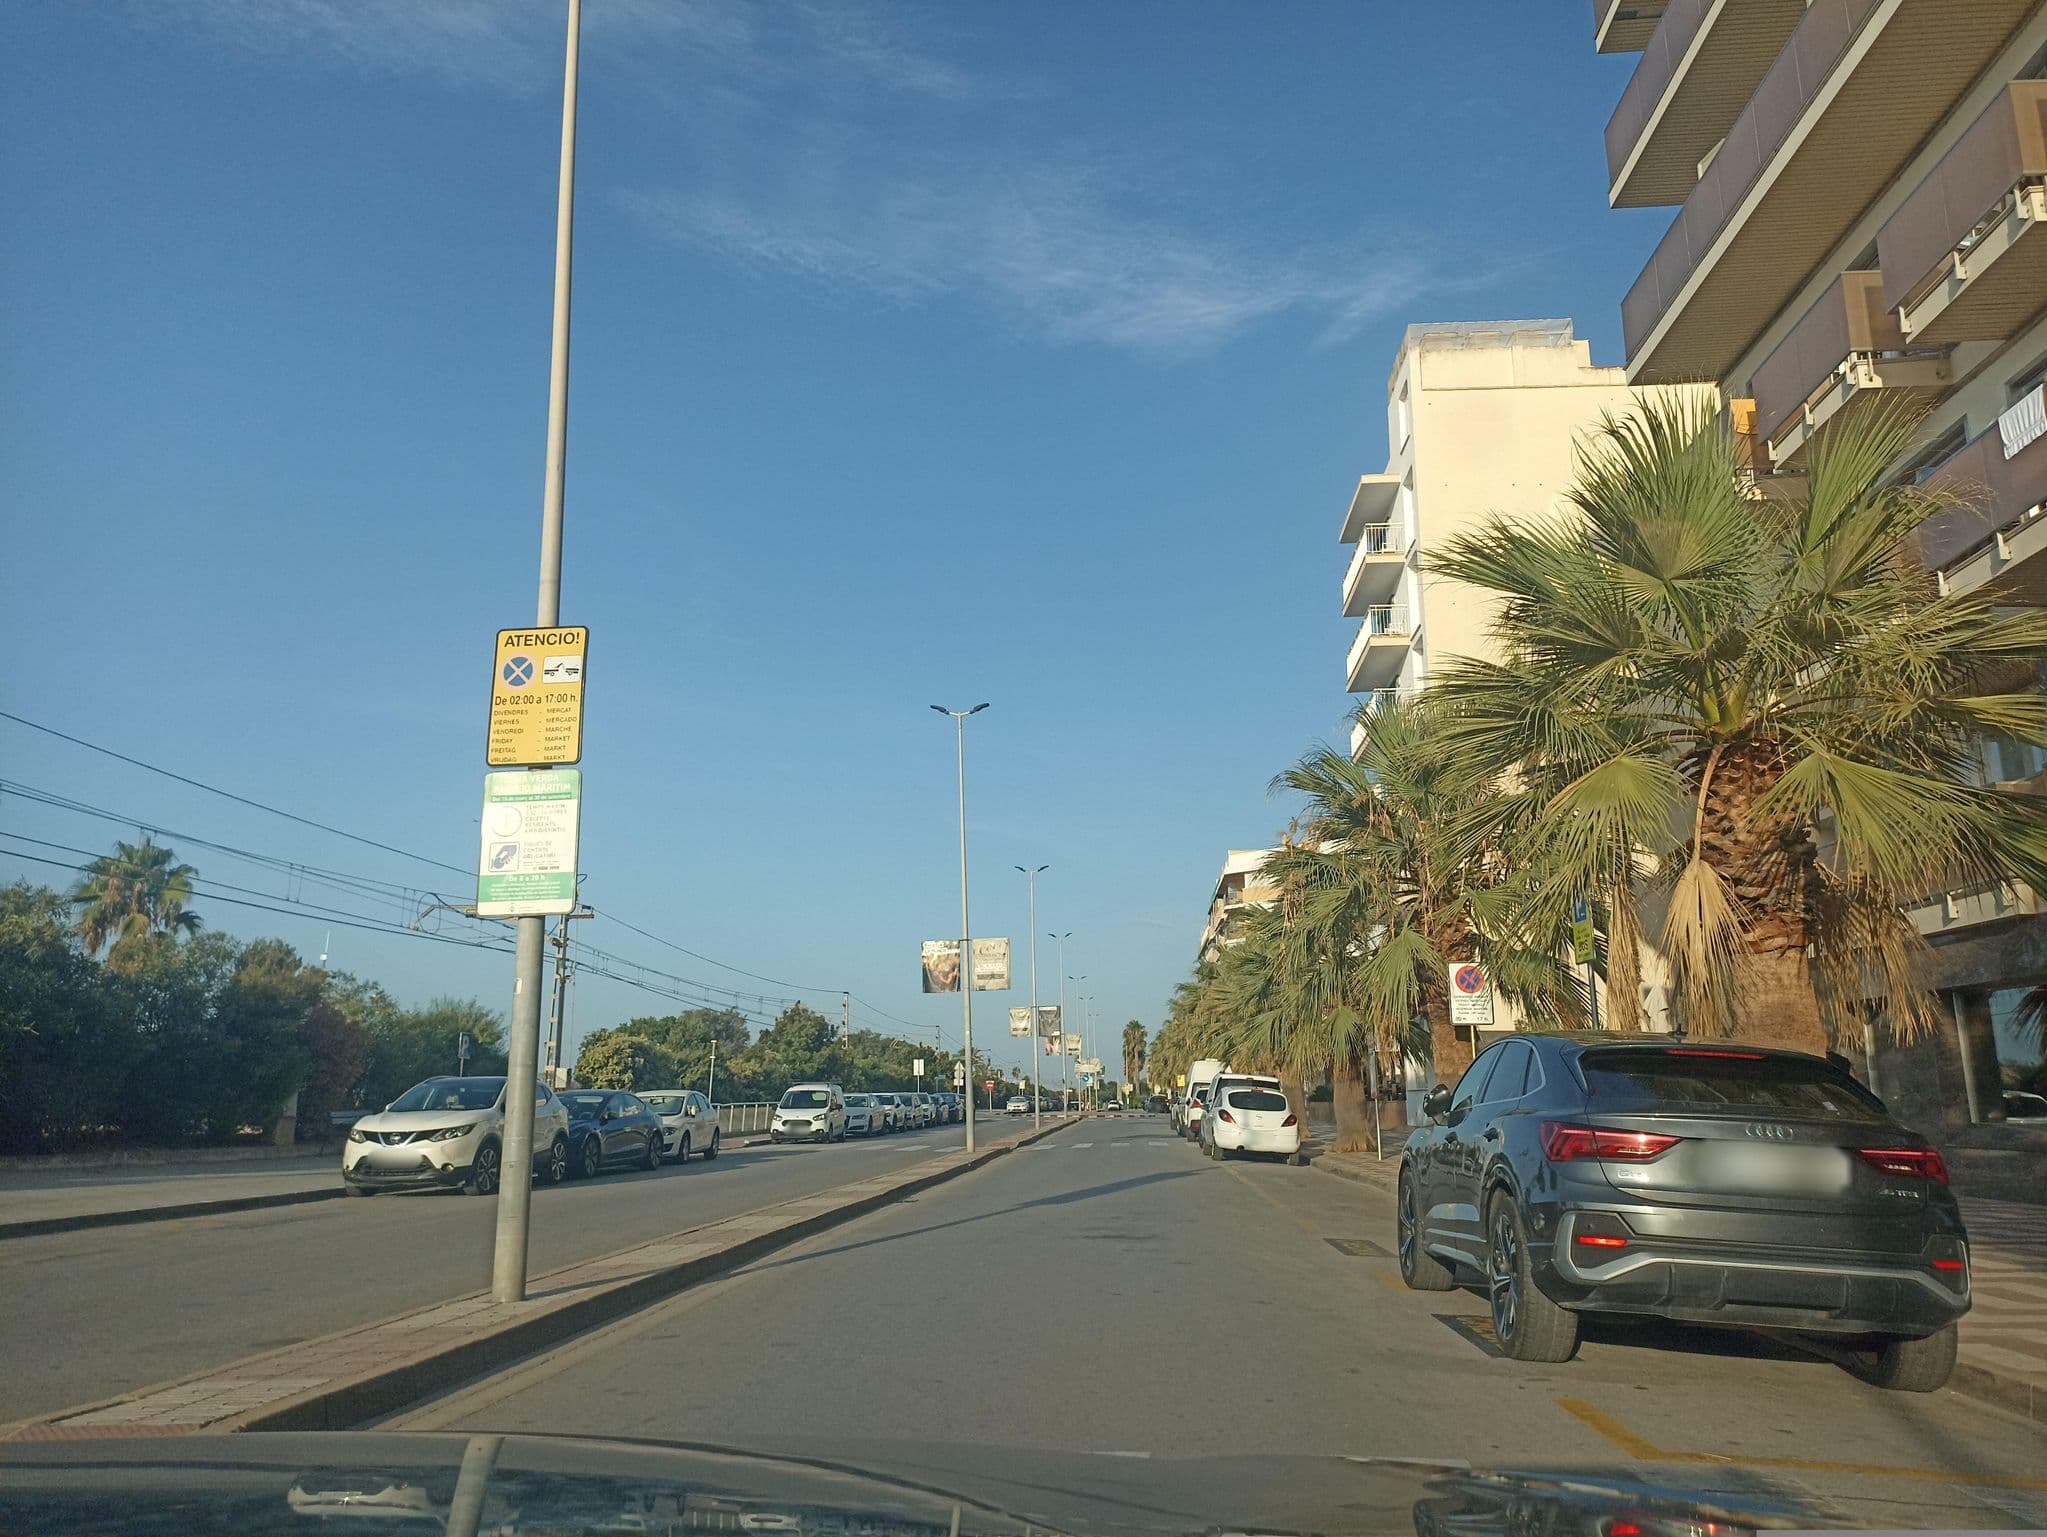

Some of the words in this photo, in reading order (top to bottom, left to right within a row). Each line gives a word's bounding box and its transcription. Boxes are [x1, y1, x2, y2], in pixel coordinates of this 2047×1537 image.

[494, 696, 507, 705] De
[509, 695, 534, 705] 02:00
[545, 693, 568, 703] 17:00
